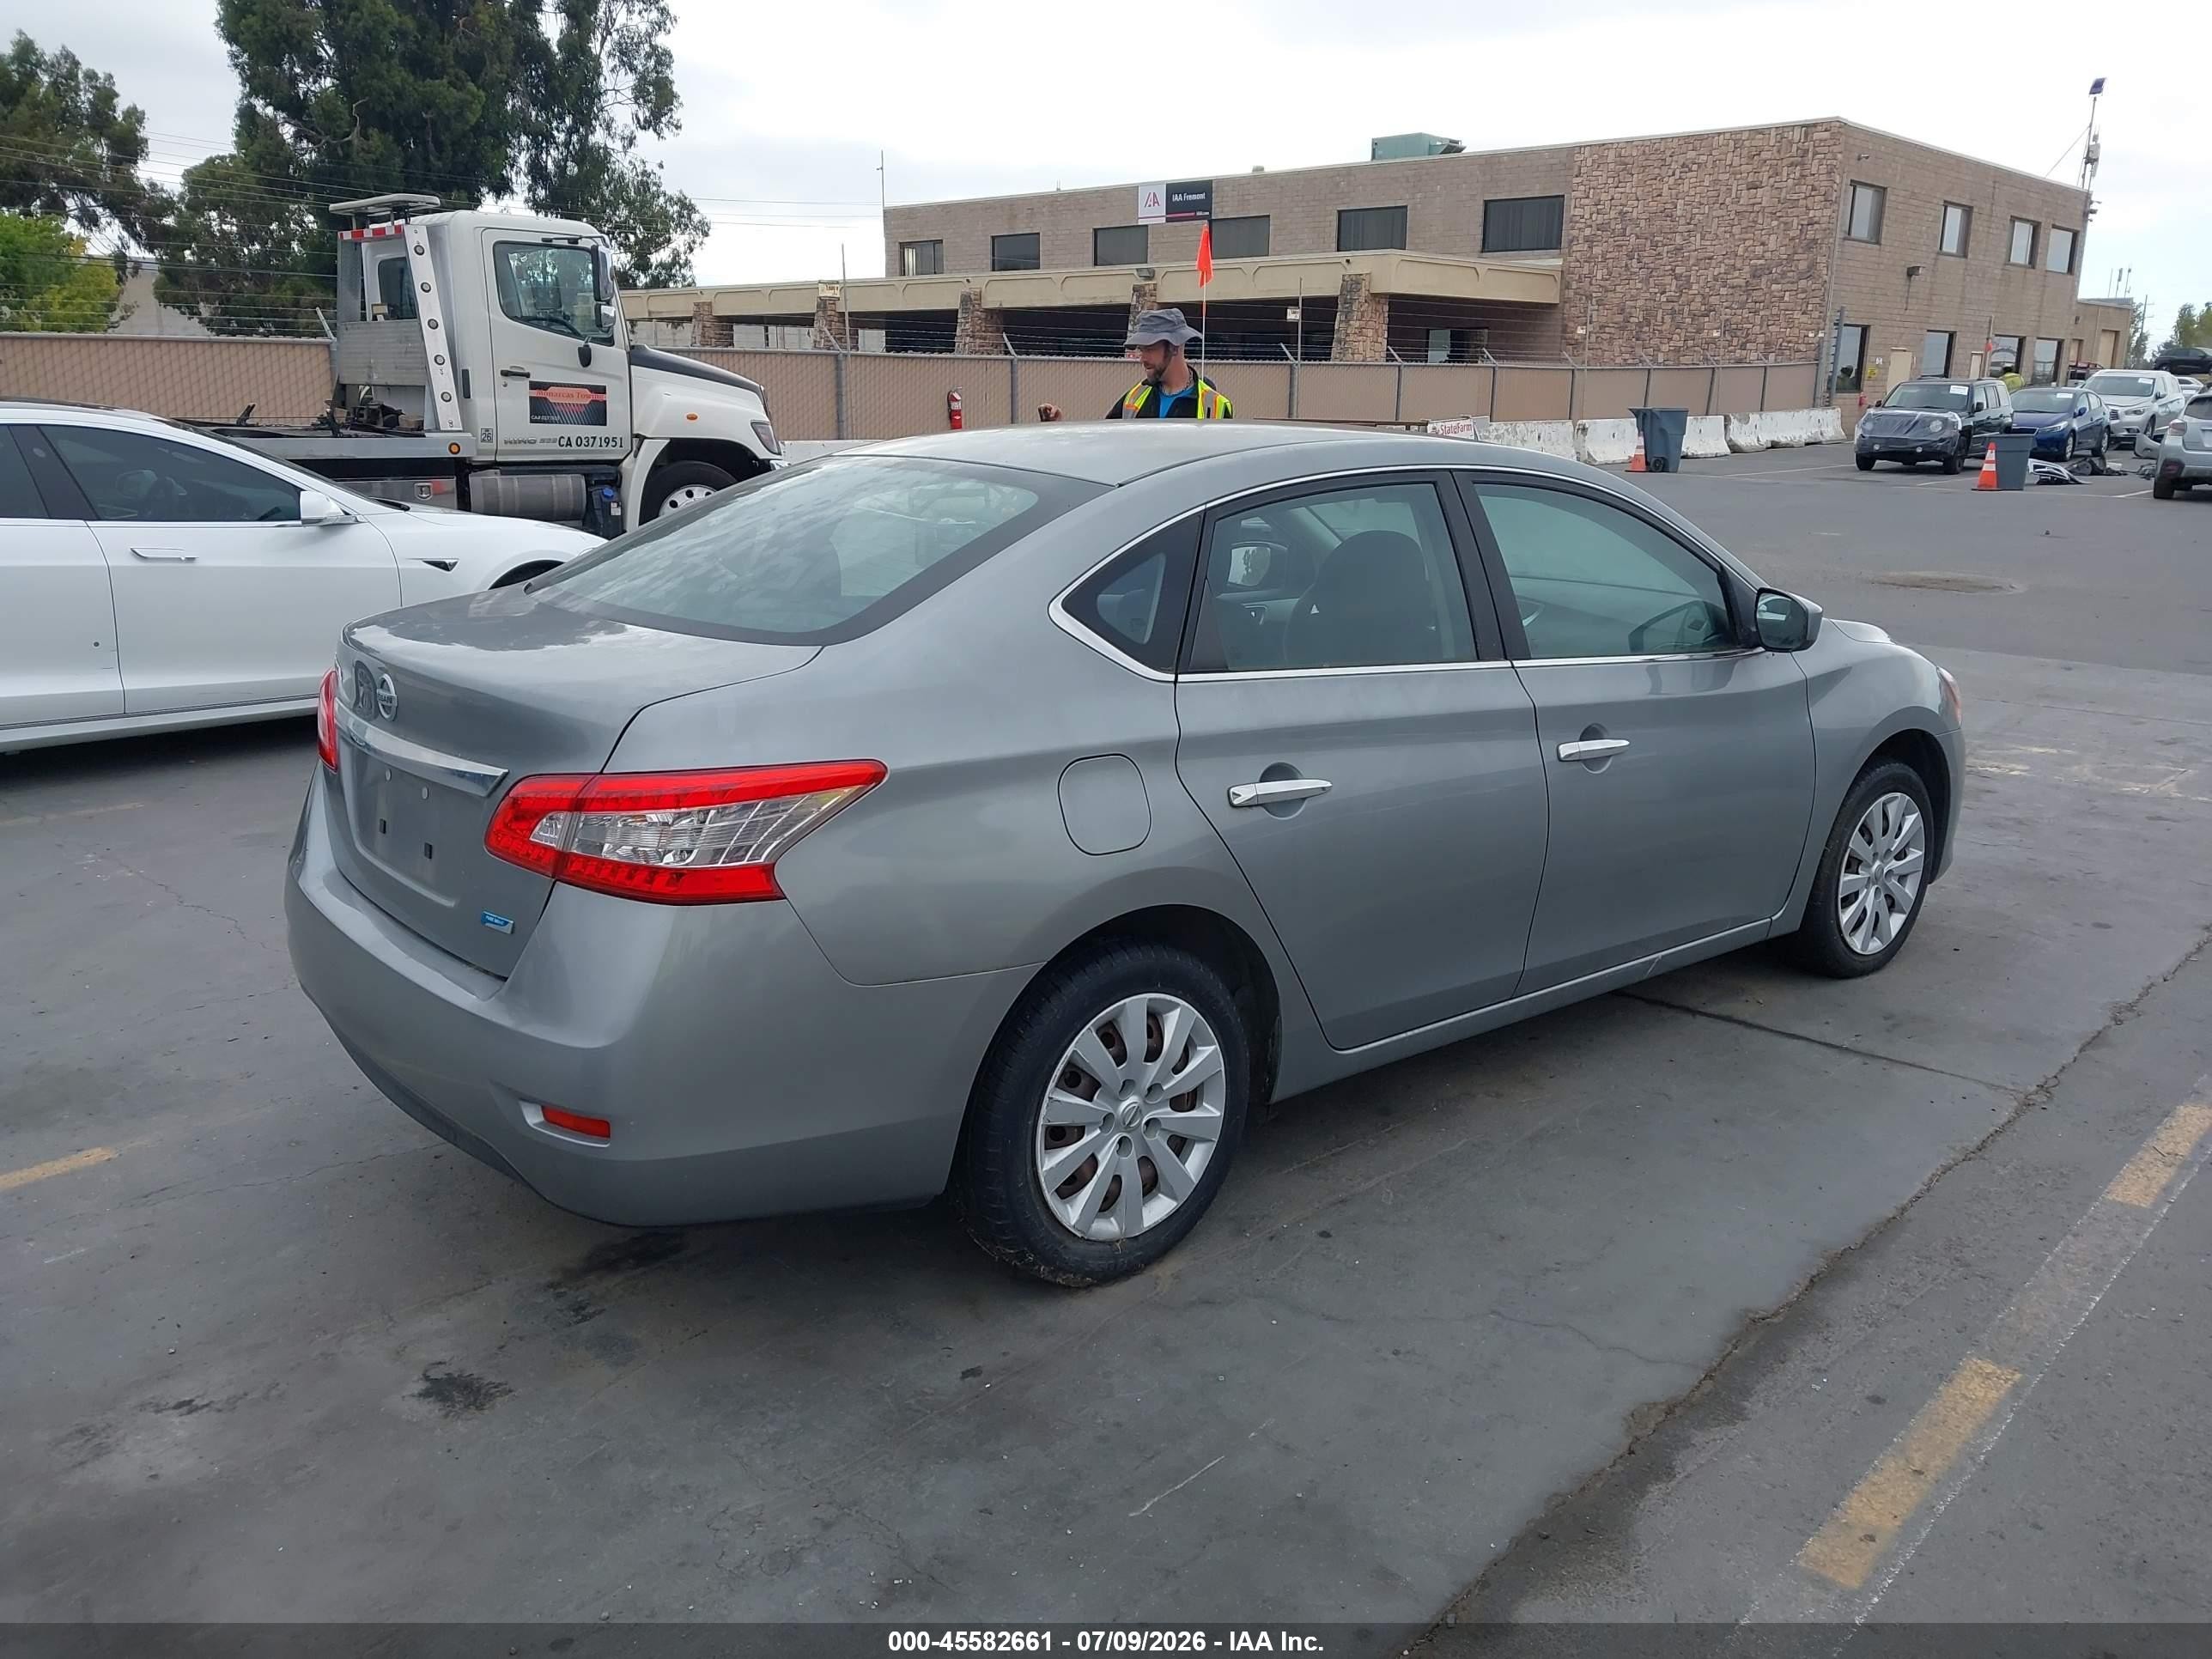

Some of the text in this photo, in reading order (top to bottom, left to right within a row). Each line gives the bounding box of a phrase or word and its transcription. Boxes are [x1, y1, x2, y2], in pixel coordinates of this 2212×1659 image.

[1172, 191, 1206, 202] IAA Fremont
[482, 432, 492, 441] 26
[558, 435, 573, 448] CA
[575, 435, 623, 448] 0371951
